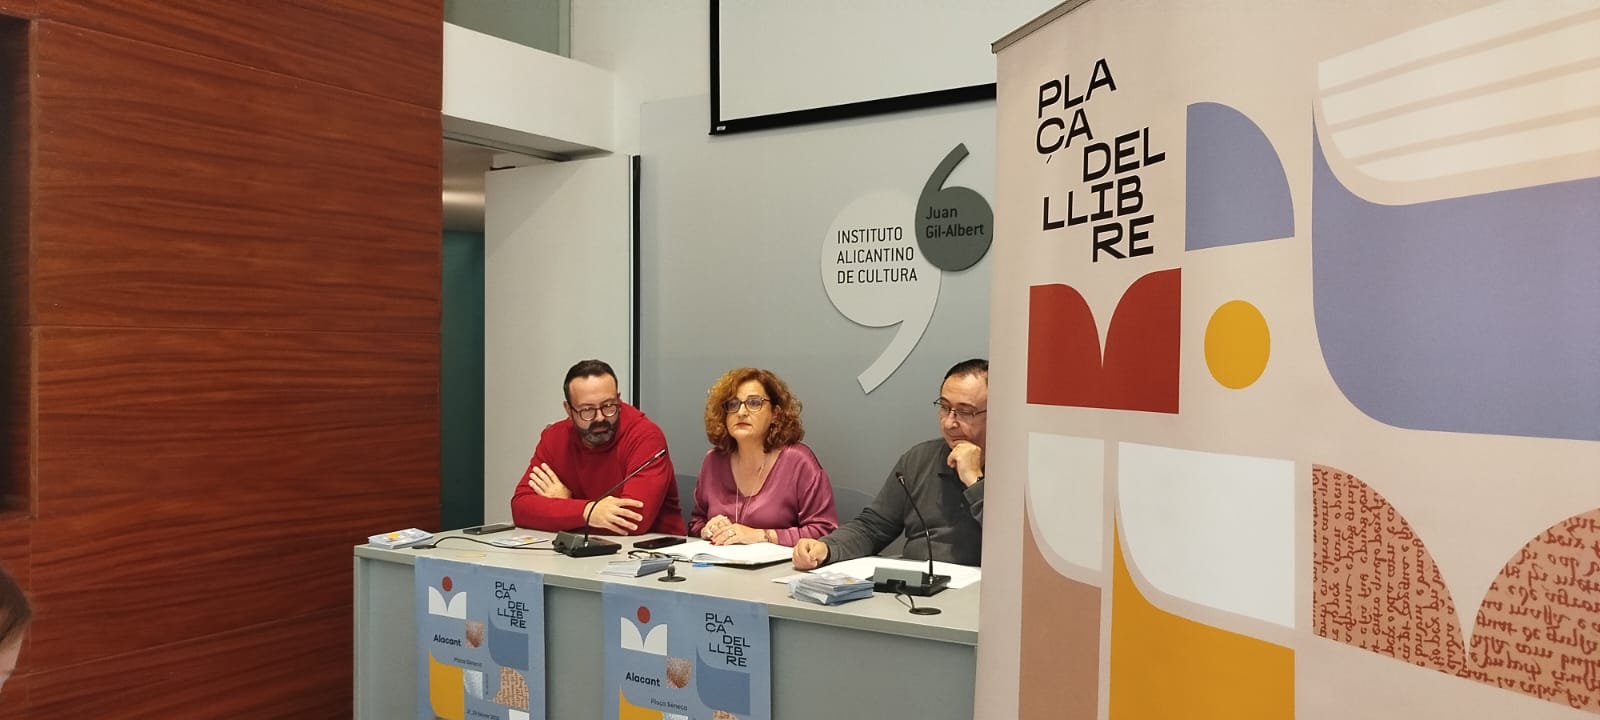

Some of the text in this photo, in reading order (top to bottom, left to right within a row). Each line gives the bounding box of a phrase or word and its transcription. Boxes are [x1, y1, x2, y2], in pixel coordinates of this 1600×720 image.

[1038, 58, 1117, 118] PLA
[1036, 108, 1093, 164] ÇA
[1083, 127, 1166, 182] DEL
[1043, 174, 1144, 231] LLIB
[925, 207, 958, 220] Juan
[837, 226, 903, 244] INSTITUTO
[926, 224, 985, 239] Gil-Albert
[1092, 215, 1154, 263] RE
[837, 247, 914, 264] ALICANTINO
[837, 268, 918, 284] DE CULTURA
[495, 581, 517, 592] PLA
[508, 601, 529, 611] DEL
[497, 608, 524, 619] LLIB
[705, 612, 734, 625] PLA
[510, 619, 527, 629] RE
[433, 634, 462, 647] Alacant
[722, 635, 751, 648] DEL
[709, 643, 744, 657] LLIB
[726, 656, 748, 668] RE
[625, 672, 661, 687] Alacant
